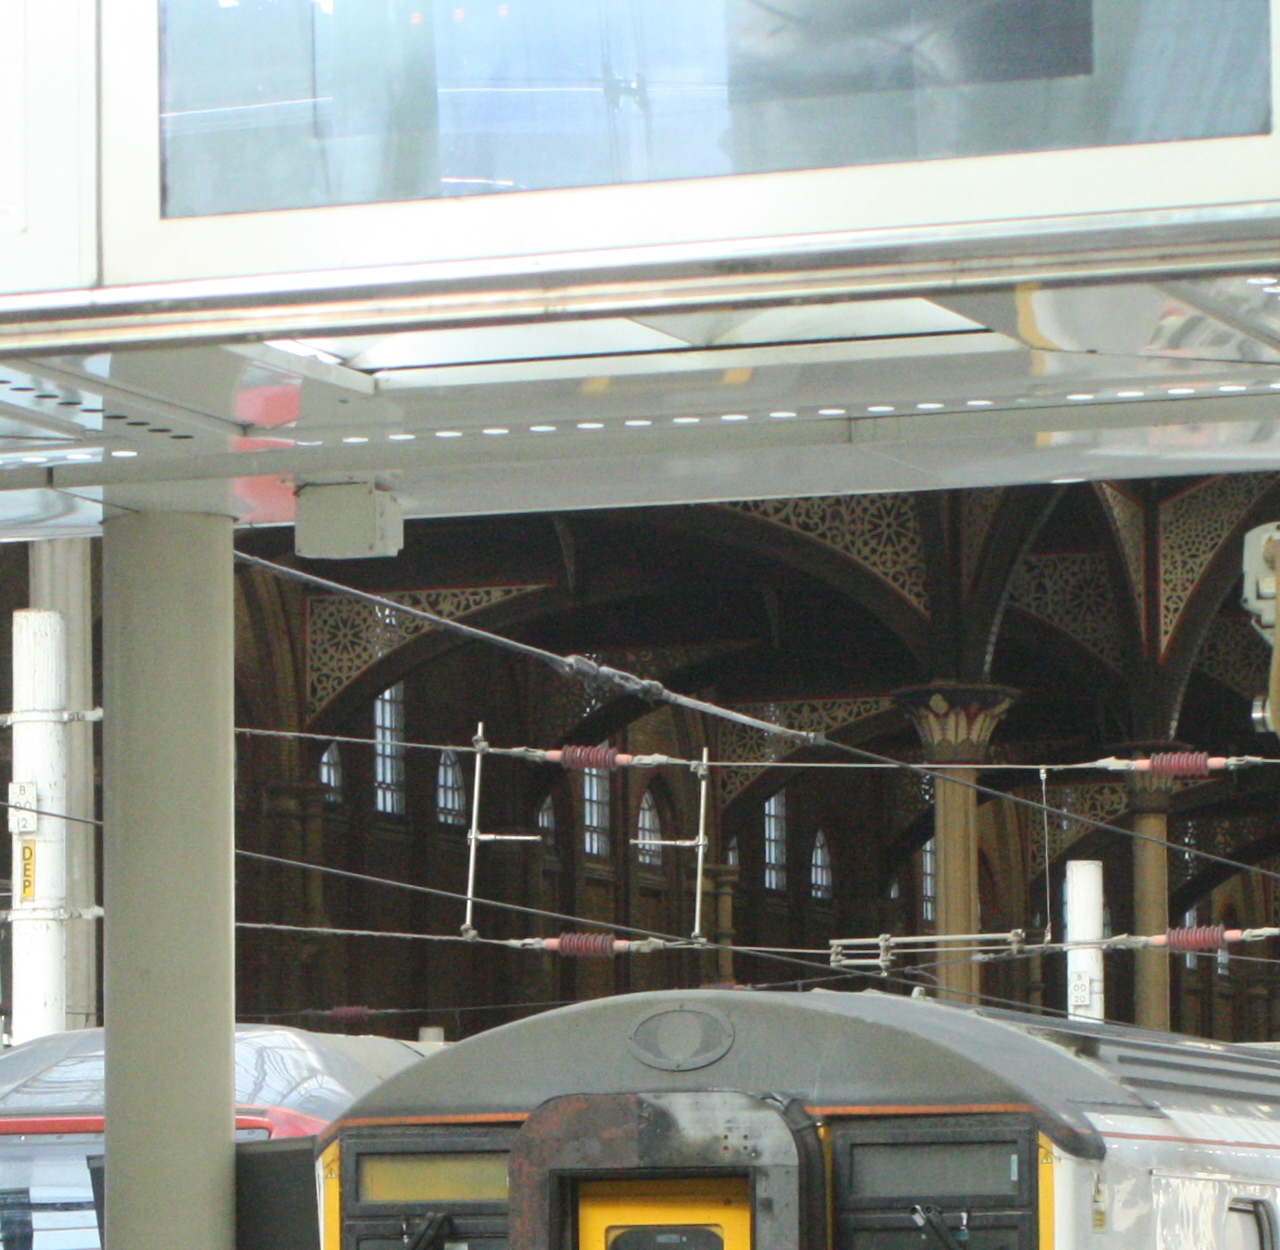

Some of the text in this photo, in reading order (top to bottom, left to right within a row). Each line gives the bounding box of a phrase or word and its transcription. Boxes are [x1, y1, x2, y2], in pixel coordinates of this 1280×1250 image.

[19, 785, 26, 796] B
[17, 817, 28, 829] 12
[22, 846, 33, 894] DEP
[1073, 984, 1086, 992] 00
